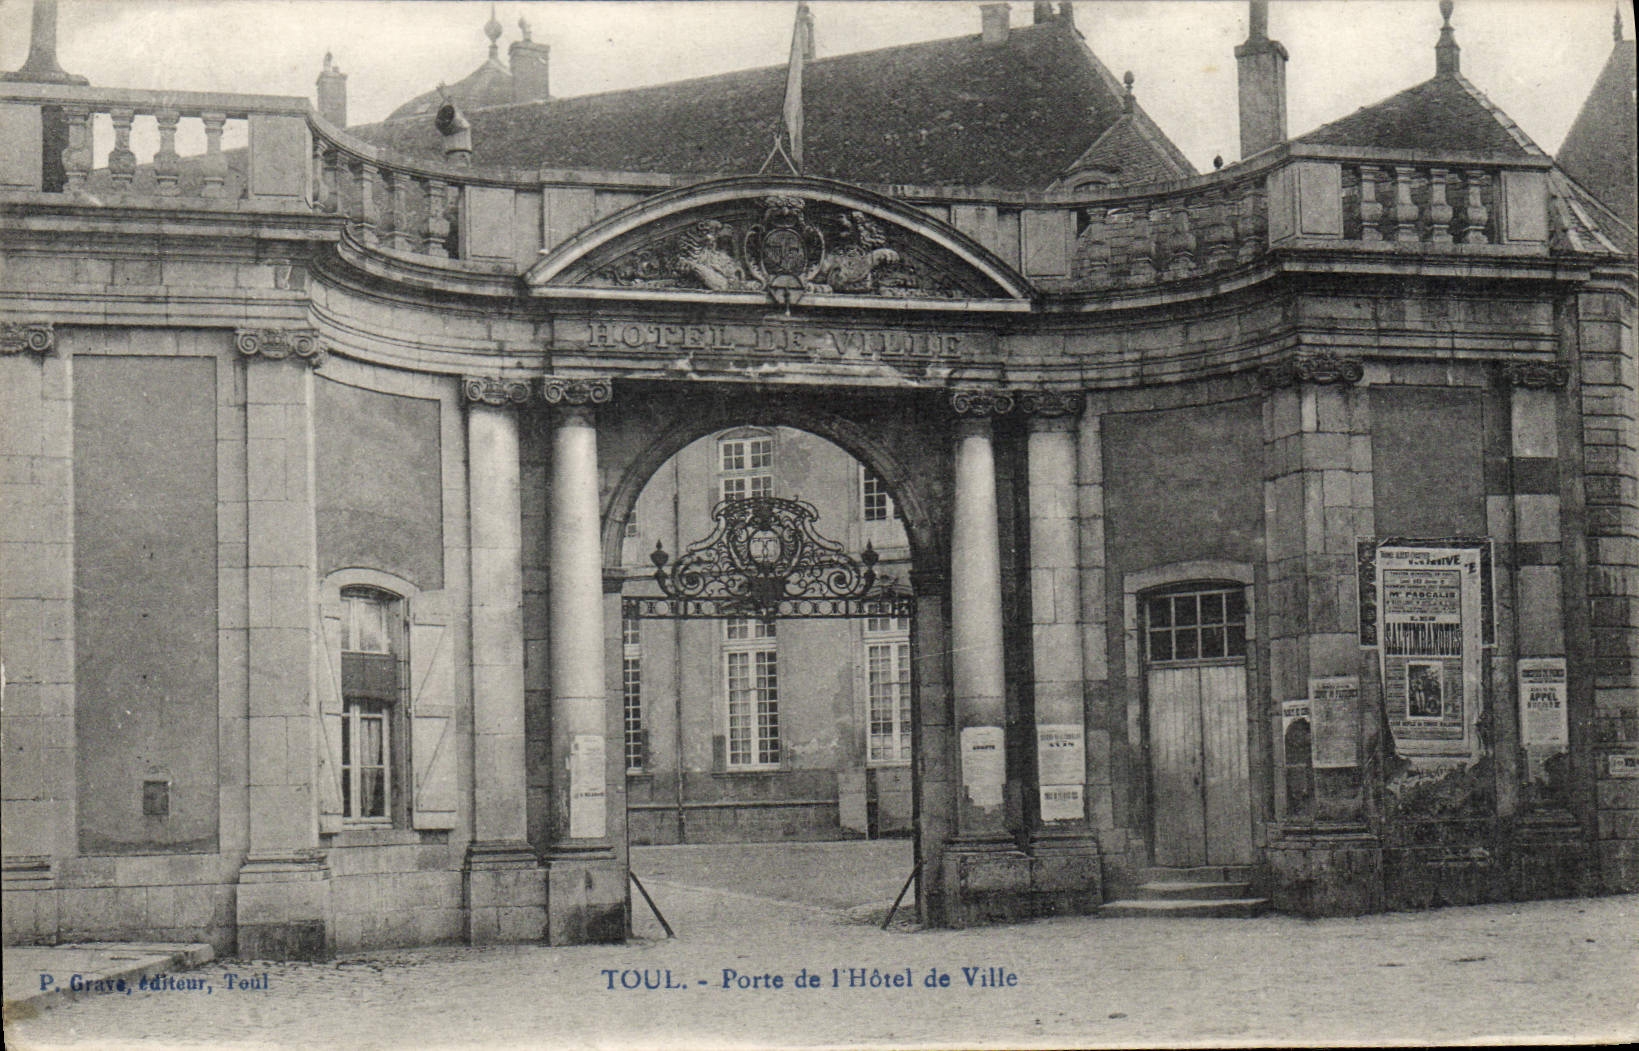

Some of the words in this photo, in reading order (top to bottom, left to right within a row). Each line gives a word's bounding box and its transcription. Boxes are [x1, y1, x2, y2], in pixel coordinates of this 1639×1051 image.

[586, 321, 735, 351] HOTEL
[753, 325, 809, 355] DE
[828, 329, 963, 359] VILLE
[1384, 621, 1462, 656] SALTIMBANQUES
[1530, 692, 1559, 702] APPEL
